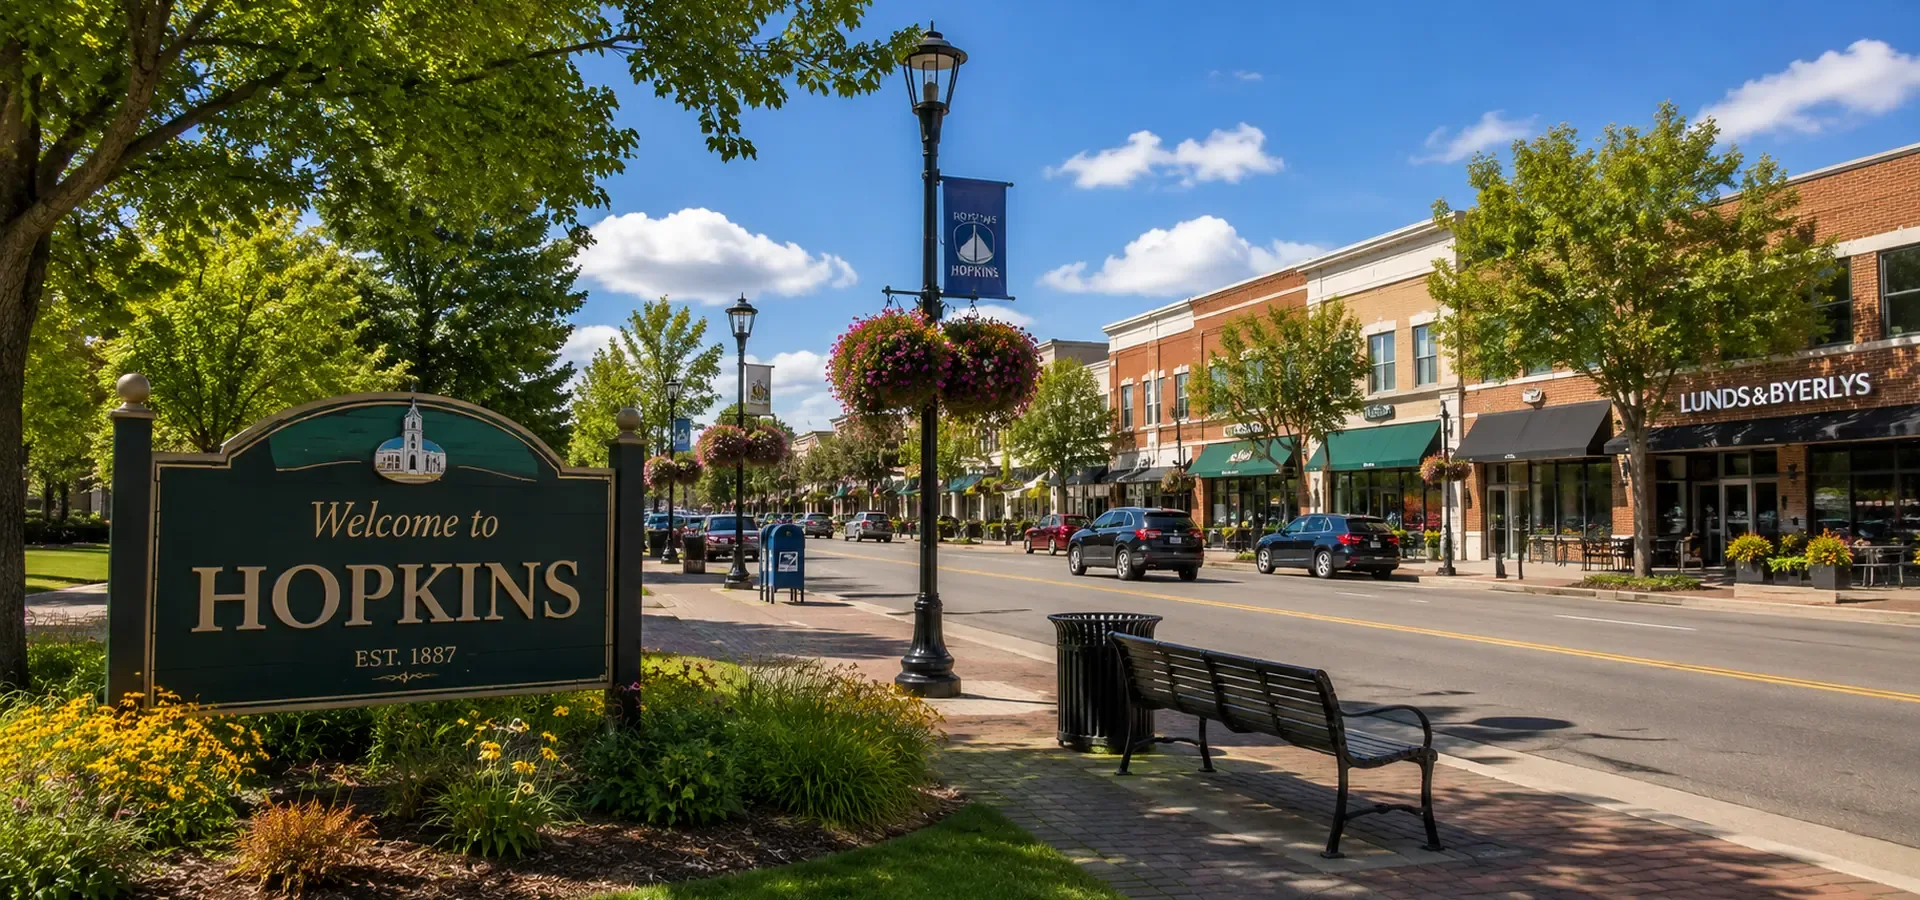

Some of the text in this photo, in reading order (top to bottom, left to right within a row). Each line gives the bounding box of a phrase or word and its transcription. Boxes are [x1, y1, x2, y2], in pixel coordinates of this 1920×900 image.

[951, 265, 999, 278] HOPKINS
[311, 500, 499, 538] Welcome to
[191, 560, 581, 633] HOPKINS
[355, 646, 457, 668] EST. 1887
